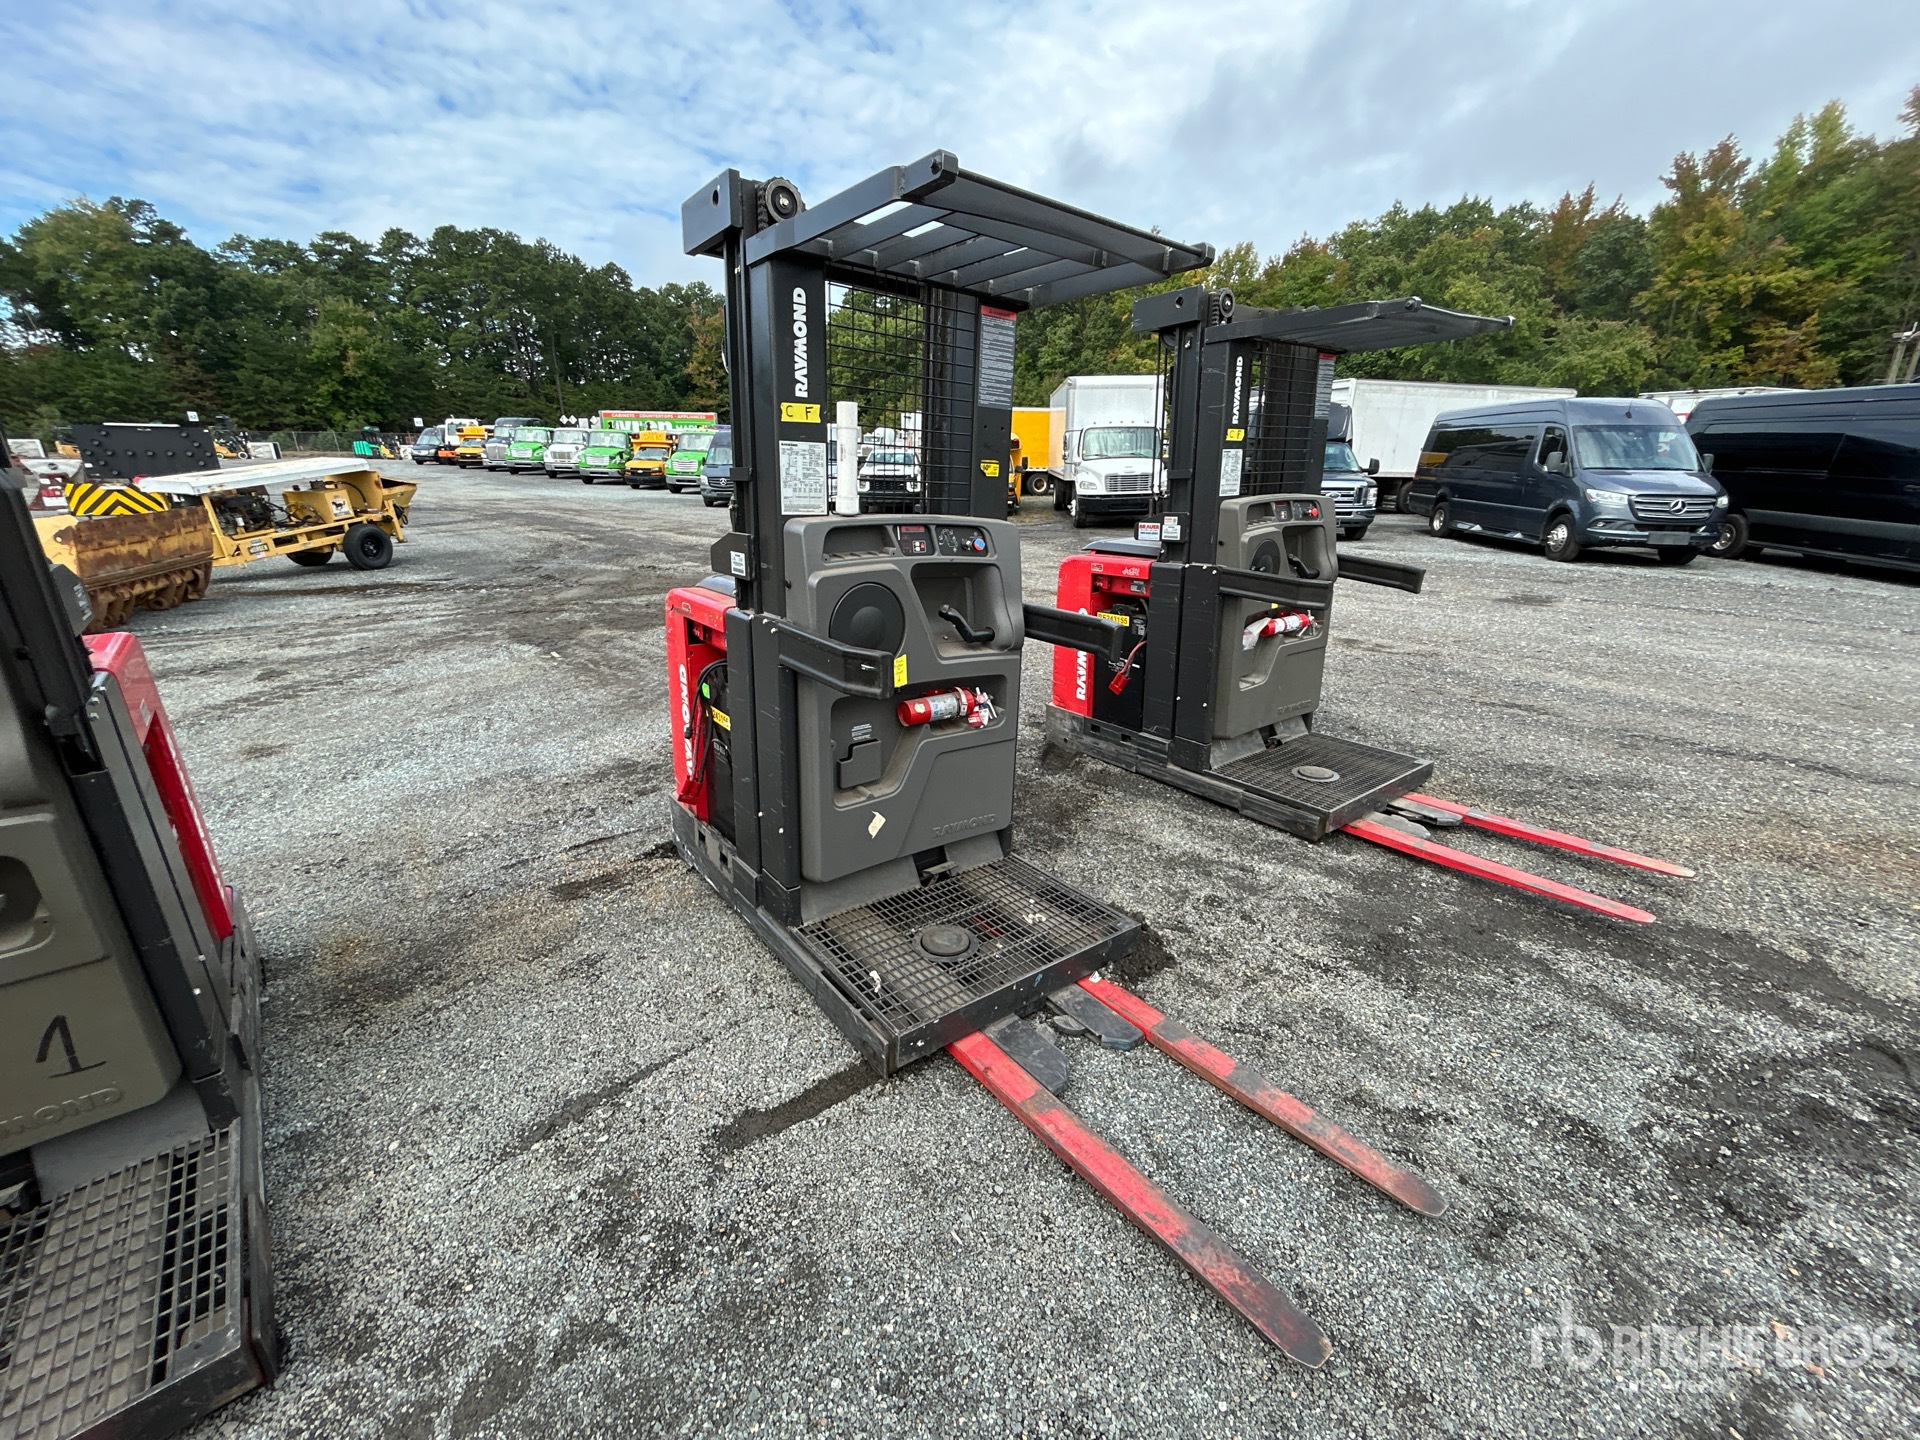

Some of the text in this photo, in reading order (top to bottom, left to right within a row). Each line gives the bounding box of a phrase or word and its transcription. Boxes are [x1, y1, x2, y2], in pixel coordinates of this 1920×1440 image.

[793, 287, 808, 398] RAYMOND
[785, 405, 814, 420] C F
[1232, 355, 1244, 425] RAYMOND
[932, 813, 996, 839] RAYMOND
[35, 1014, 107, 1078] 1
[0, 1086, 125, 1138] MOND
